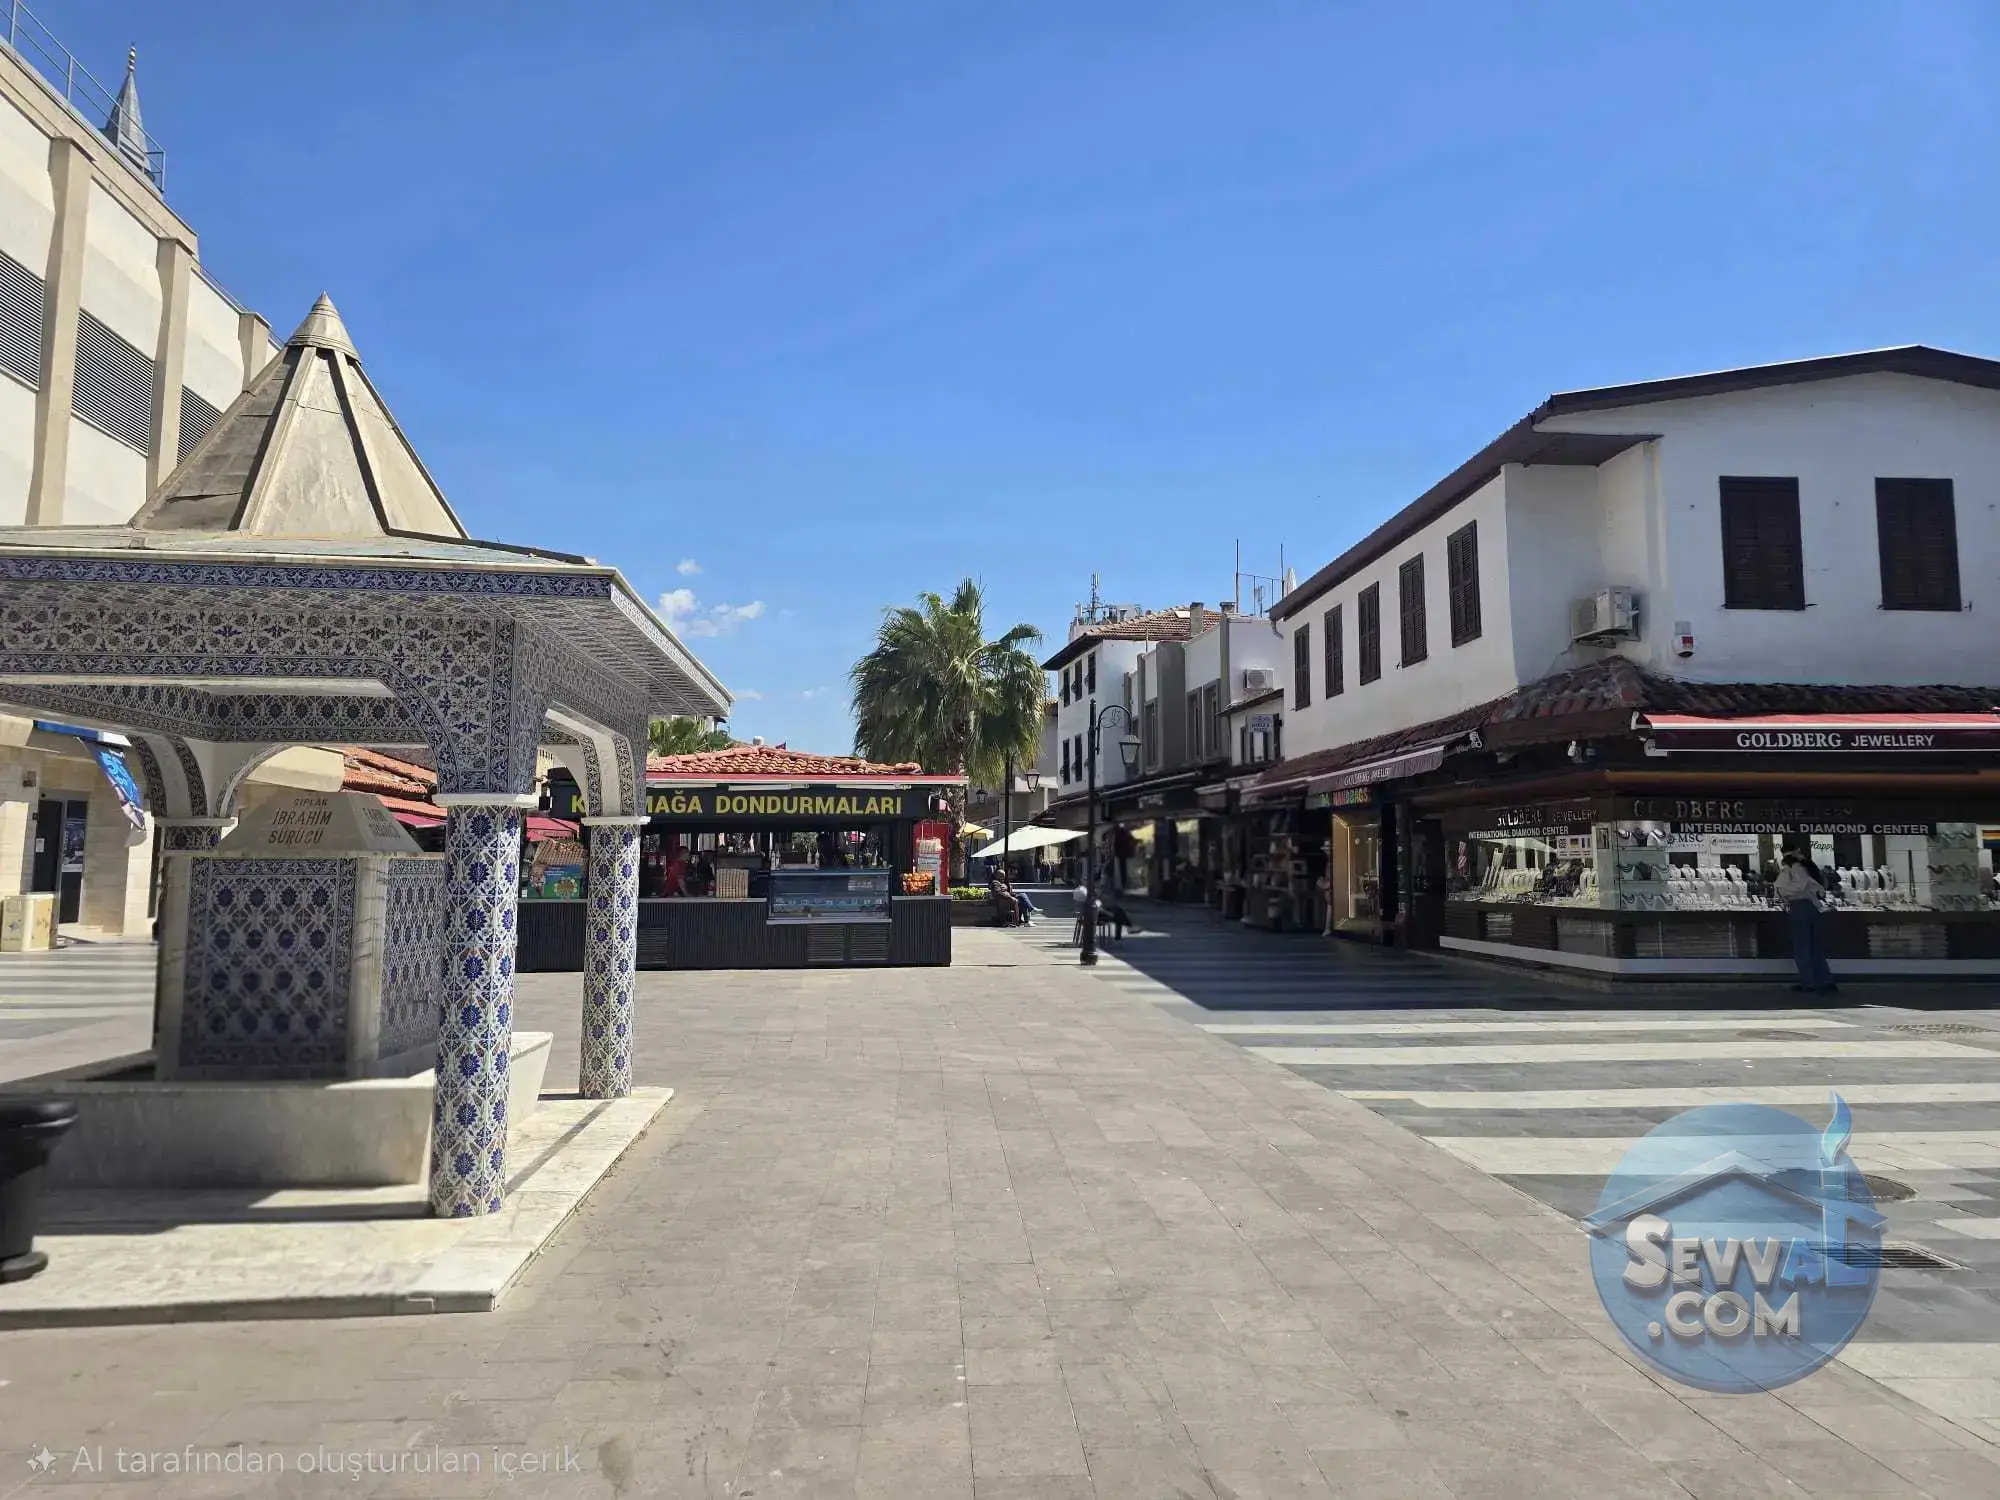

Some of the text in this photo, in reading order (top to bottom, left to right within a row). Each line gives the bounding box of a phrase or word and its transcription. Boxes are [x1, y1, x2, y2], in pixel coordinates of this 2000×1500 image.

[1736, 731, 1935, 748] GOLDBERG JEWELLERY
[570, 790, 902, 815] KAĞA DONDURMALARI
[1468, 825, 1569, 840] INTERNATIONAL DIAMOND CENTER
[1680, 823, 1929, 835] INTERNATIONAL DIAMOND CENTER
[1678, 832, 1704, 843] MSC
